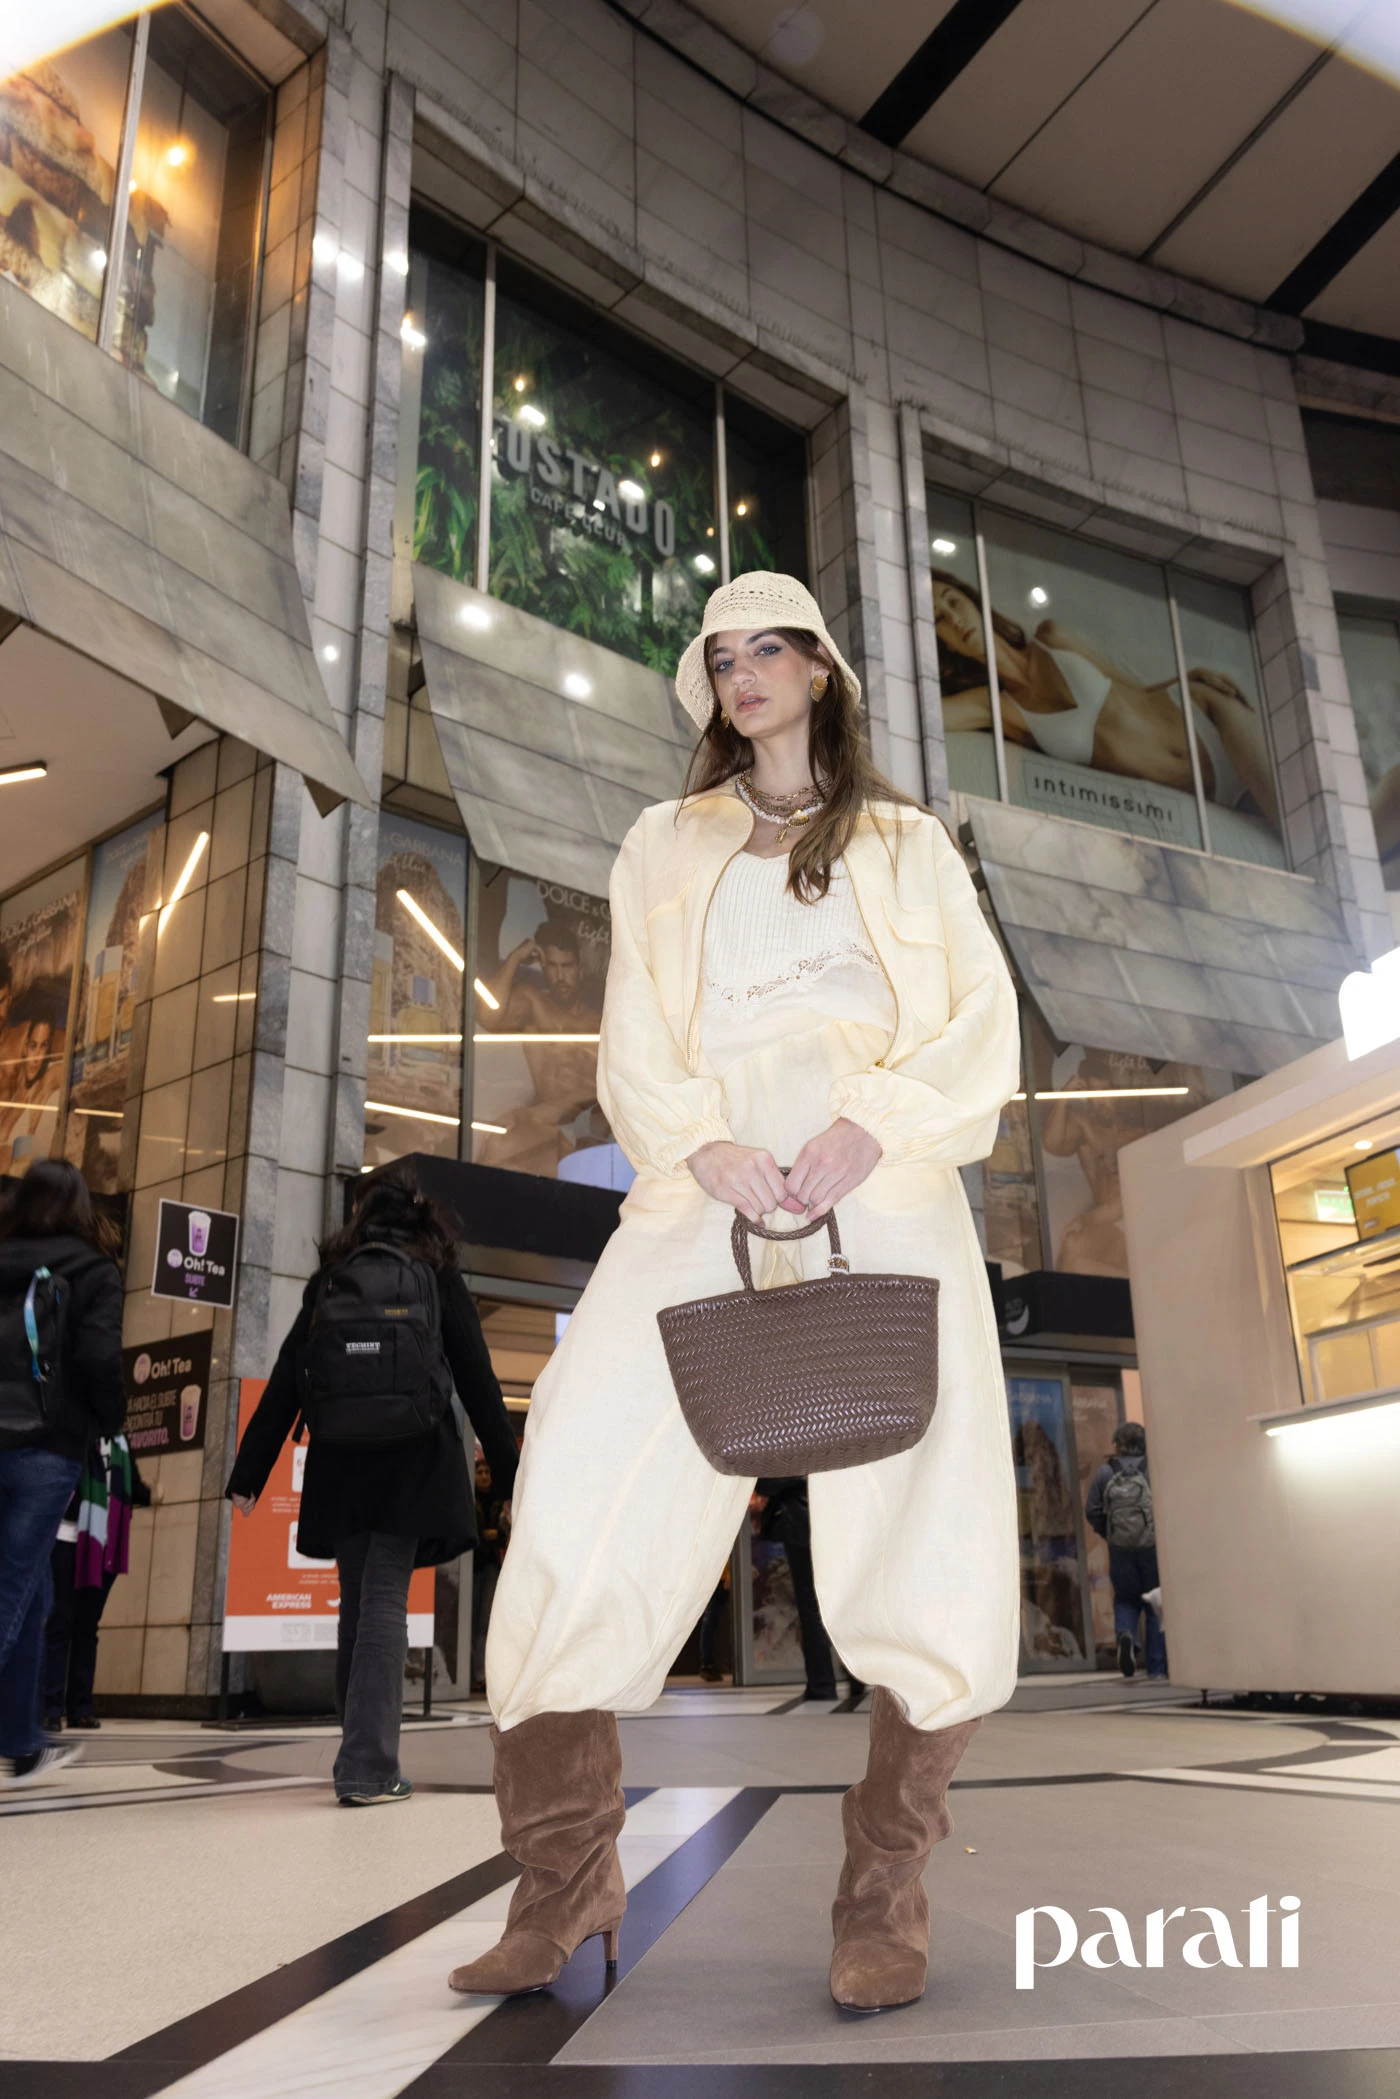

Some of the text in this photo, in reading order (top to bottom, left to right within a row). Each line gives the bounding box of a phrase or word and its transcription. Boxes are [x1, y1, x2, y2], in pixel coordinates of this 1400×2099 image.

[1034, 776, 1173, 823] intimissimi
[536, 880, 591, 914] DOLCE
[184, 1256, 226, 1276] Oh! Tea
[151, 1358, 192, 1379] Oh! Tea
[266, 1593, 312, 1601] AMERICAN
[272, 1601, 312, 1610] EXPRESS
